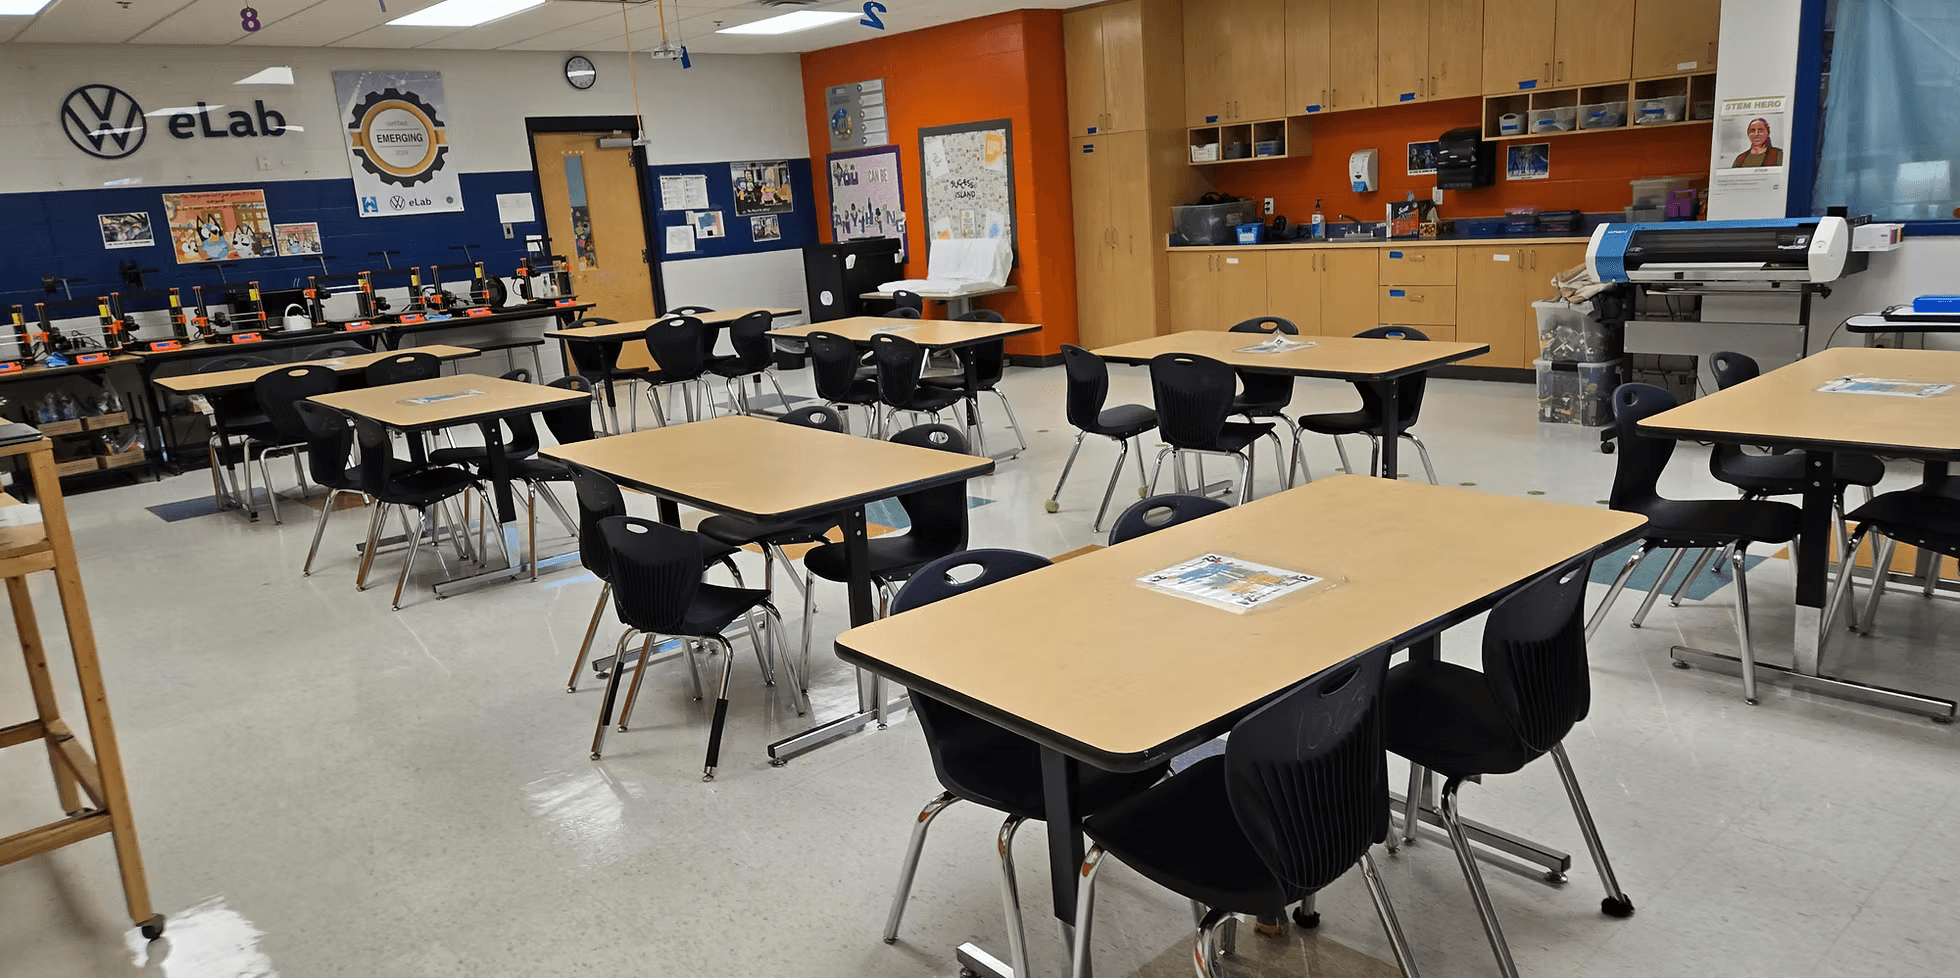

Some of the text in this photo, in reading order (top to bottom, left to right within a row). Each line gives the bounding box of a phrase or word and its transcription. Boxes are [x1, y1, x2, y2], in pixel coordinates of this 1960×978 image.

[240, 7, 261, 32] 8
[1725, 100, 1782, 111] STEM HERO
[168, 99, 286, 139] eLab
[376, 133, 424, 143] EMERGING
[833, 168, 888, 186] YOU CAN BE
[408, 197, 432, 207] eLab
